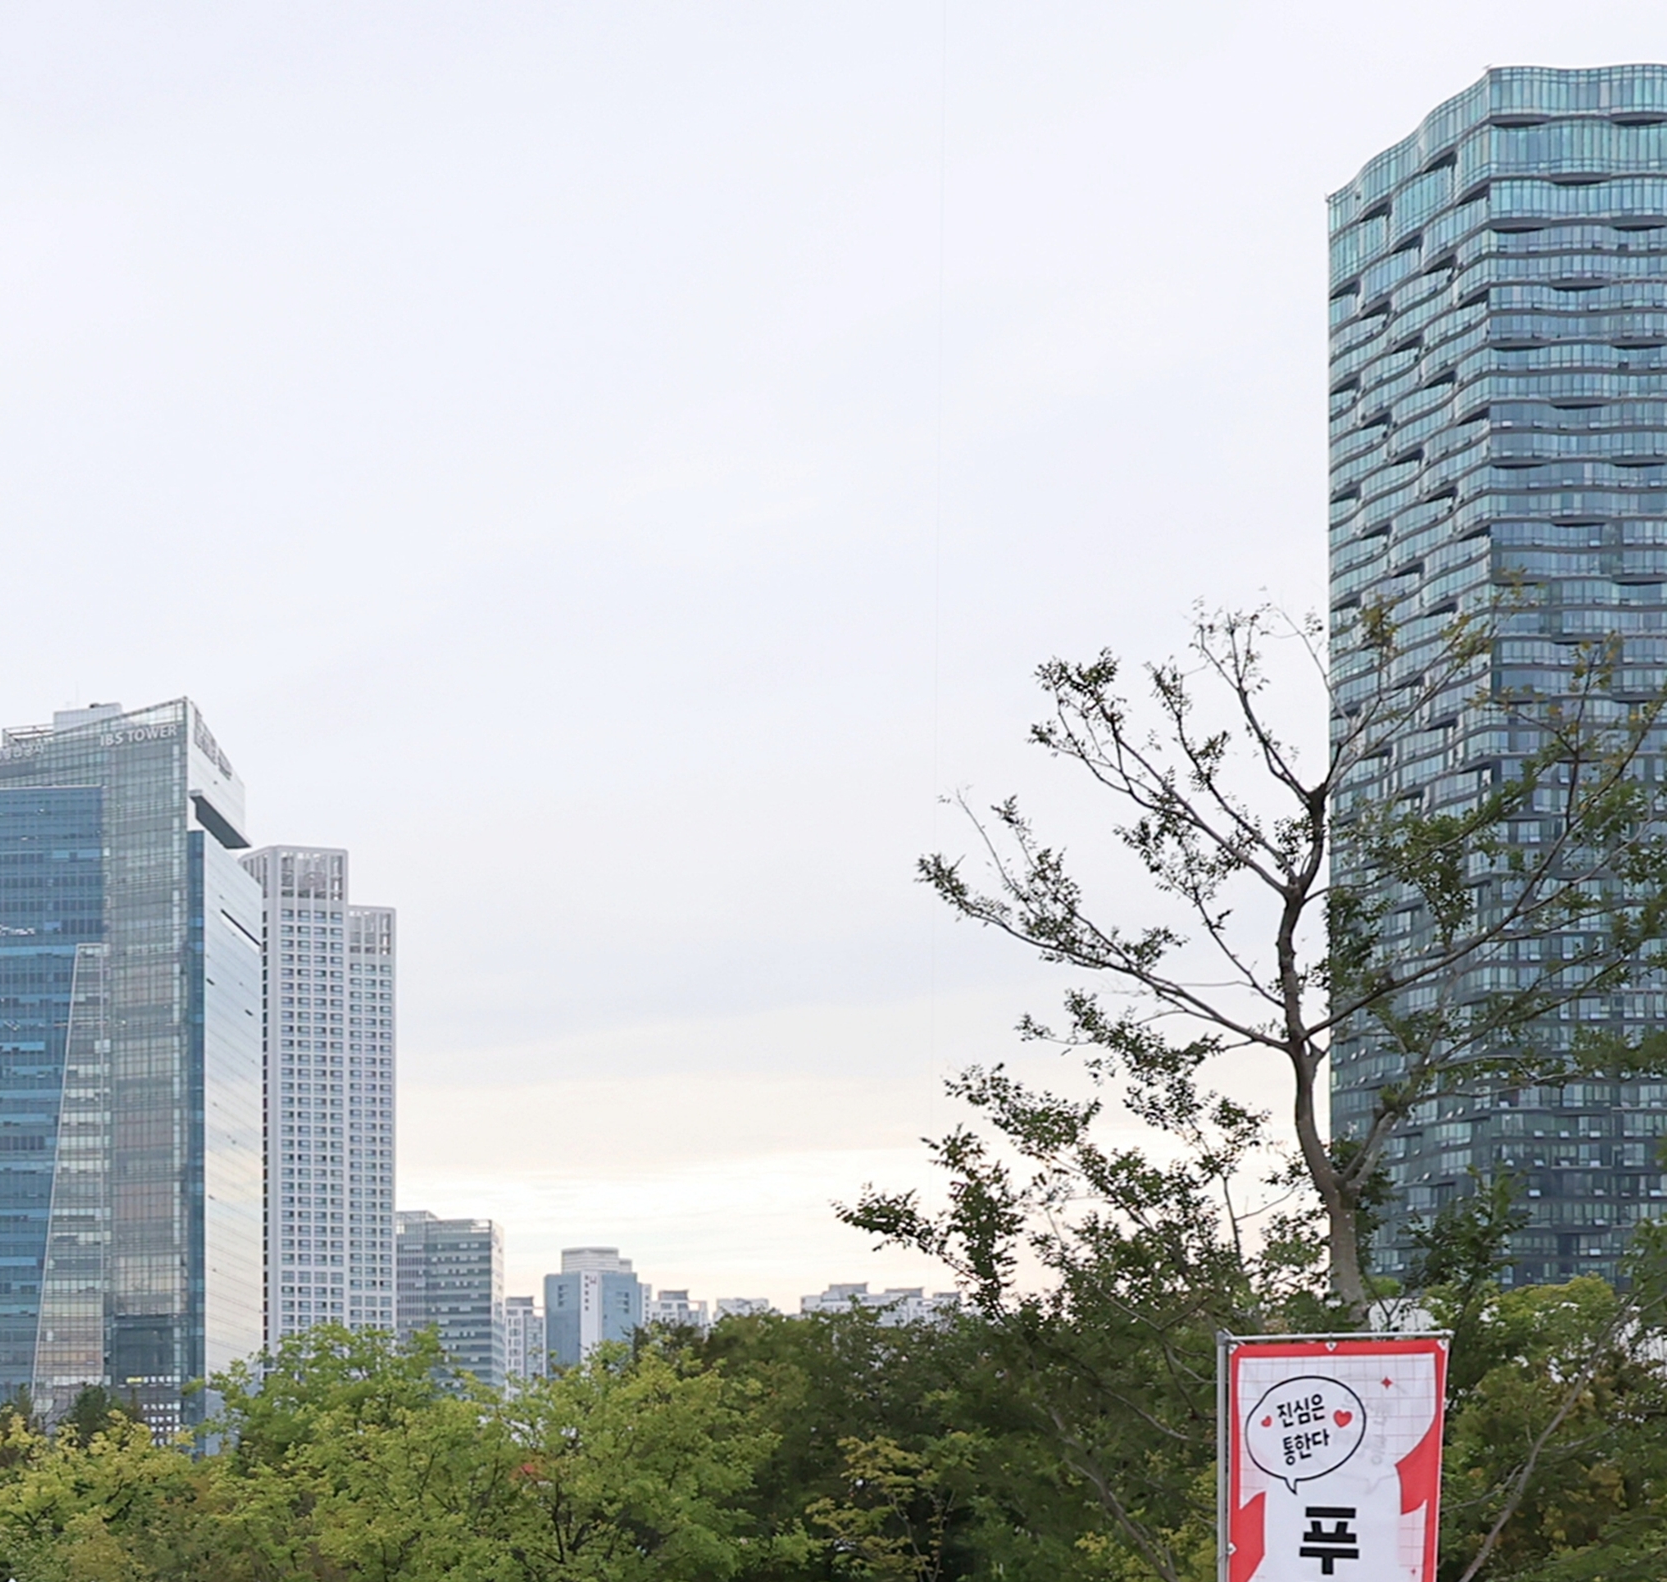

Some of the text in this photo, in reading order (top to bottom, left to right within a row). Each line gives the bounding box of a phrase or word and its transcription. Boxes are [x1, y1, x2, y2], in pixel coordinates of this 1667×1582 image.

[100, 724, 178, 747] IBS TOWER
[1277, 1393, 1326, 1429] 진심은
[1282, 1428, 1331, 1467] 통한다
